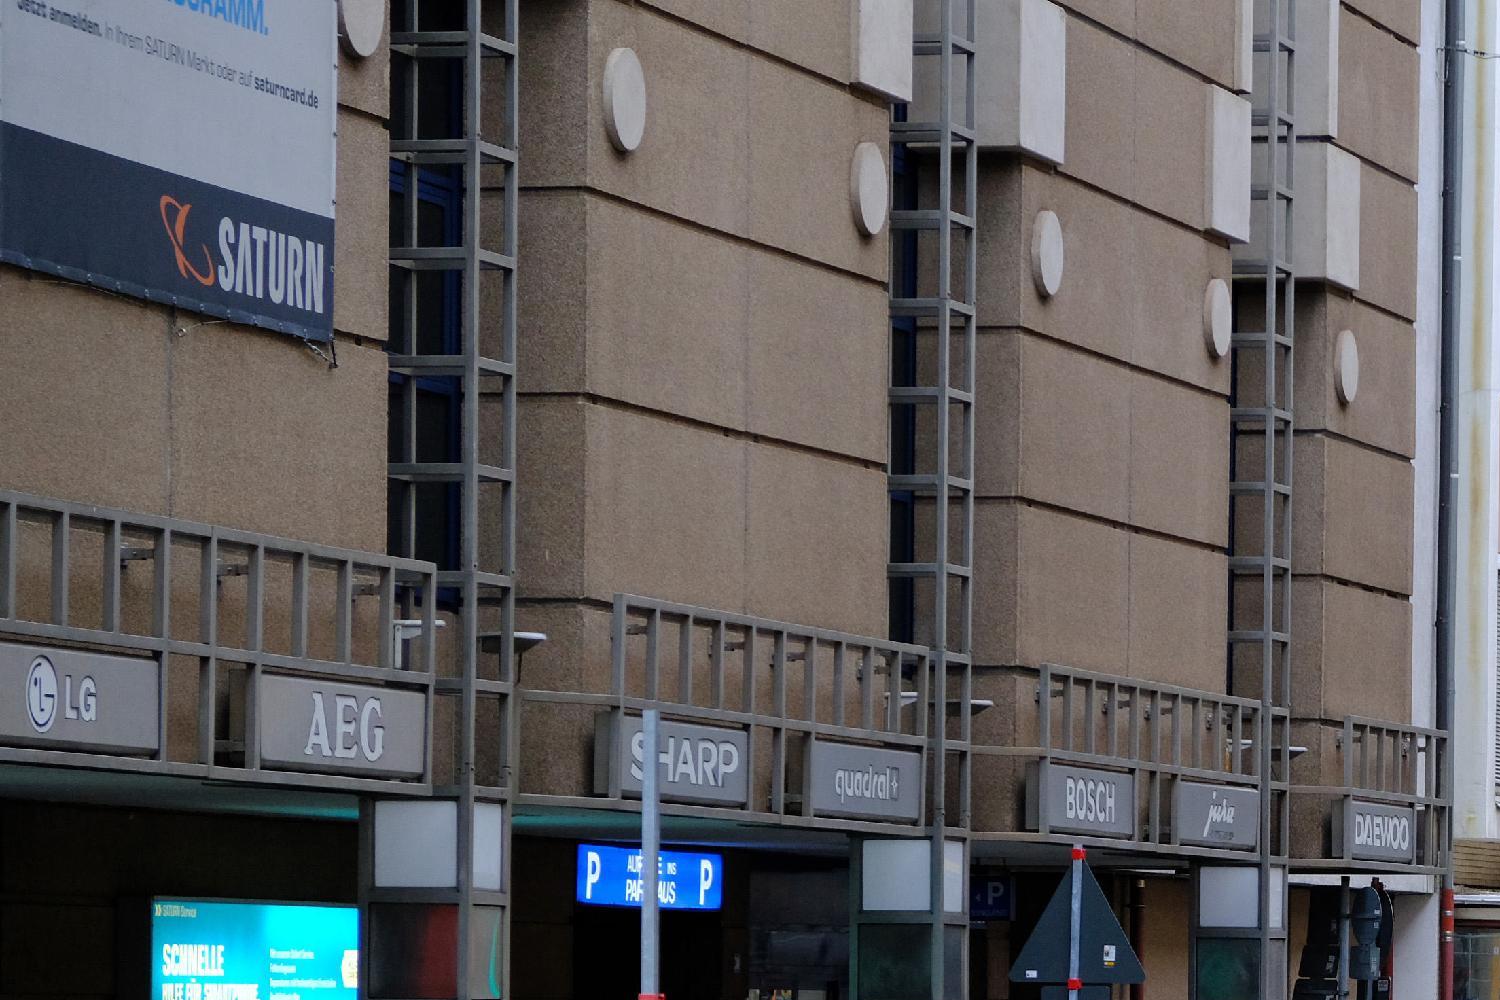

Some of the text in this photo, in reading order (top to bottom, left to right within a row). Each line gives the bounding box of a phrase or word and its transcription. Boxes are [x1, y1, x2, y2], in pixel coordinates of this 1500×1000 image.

[145, 35, 185, 66] SATURN
[254, 76, 319, 109] saturncard.de
[218, 216, 324, 314] SATURN
[65, 675, 97, 722] LG
[304, 690, 385, 762] AEG
[835, 764, 890, 804] quadral
[1066, 775, 1116, 823] BOSCH
[1354, 813, 1410, 850] DAEWOO
[585, 851, 600, 899] P
[699, 859, 713, 905] P
[162, 943, 225, 977] SCHNELLE
